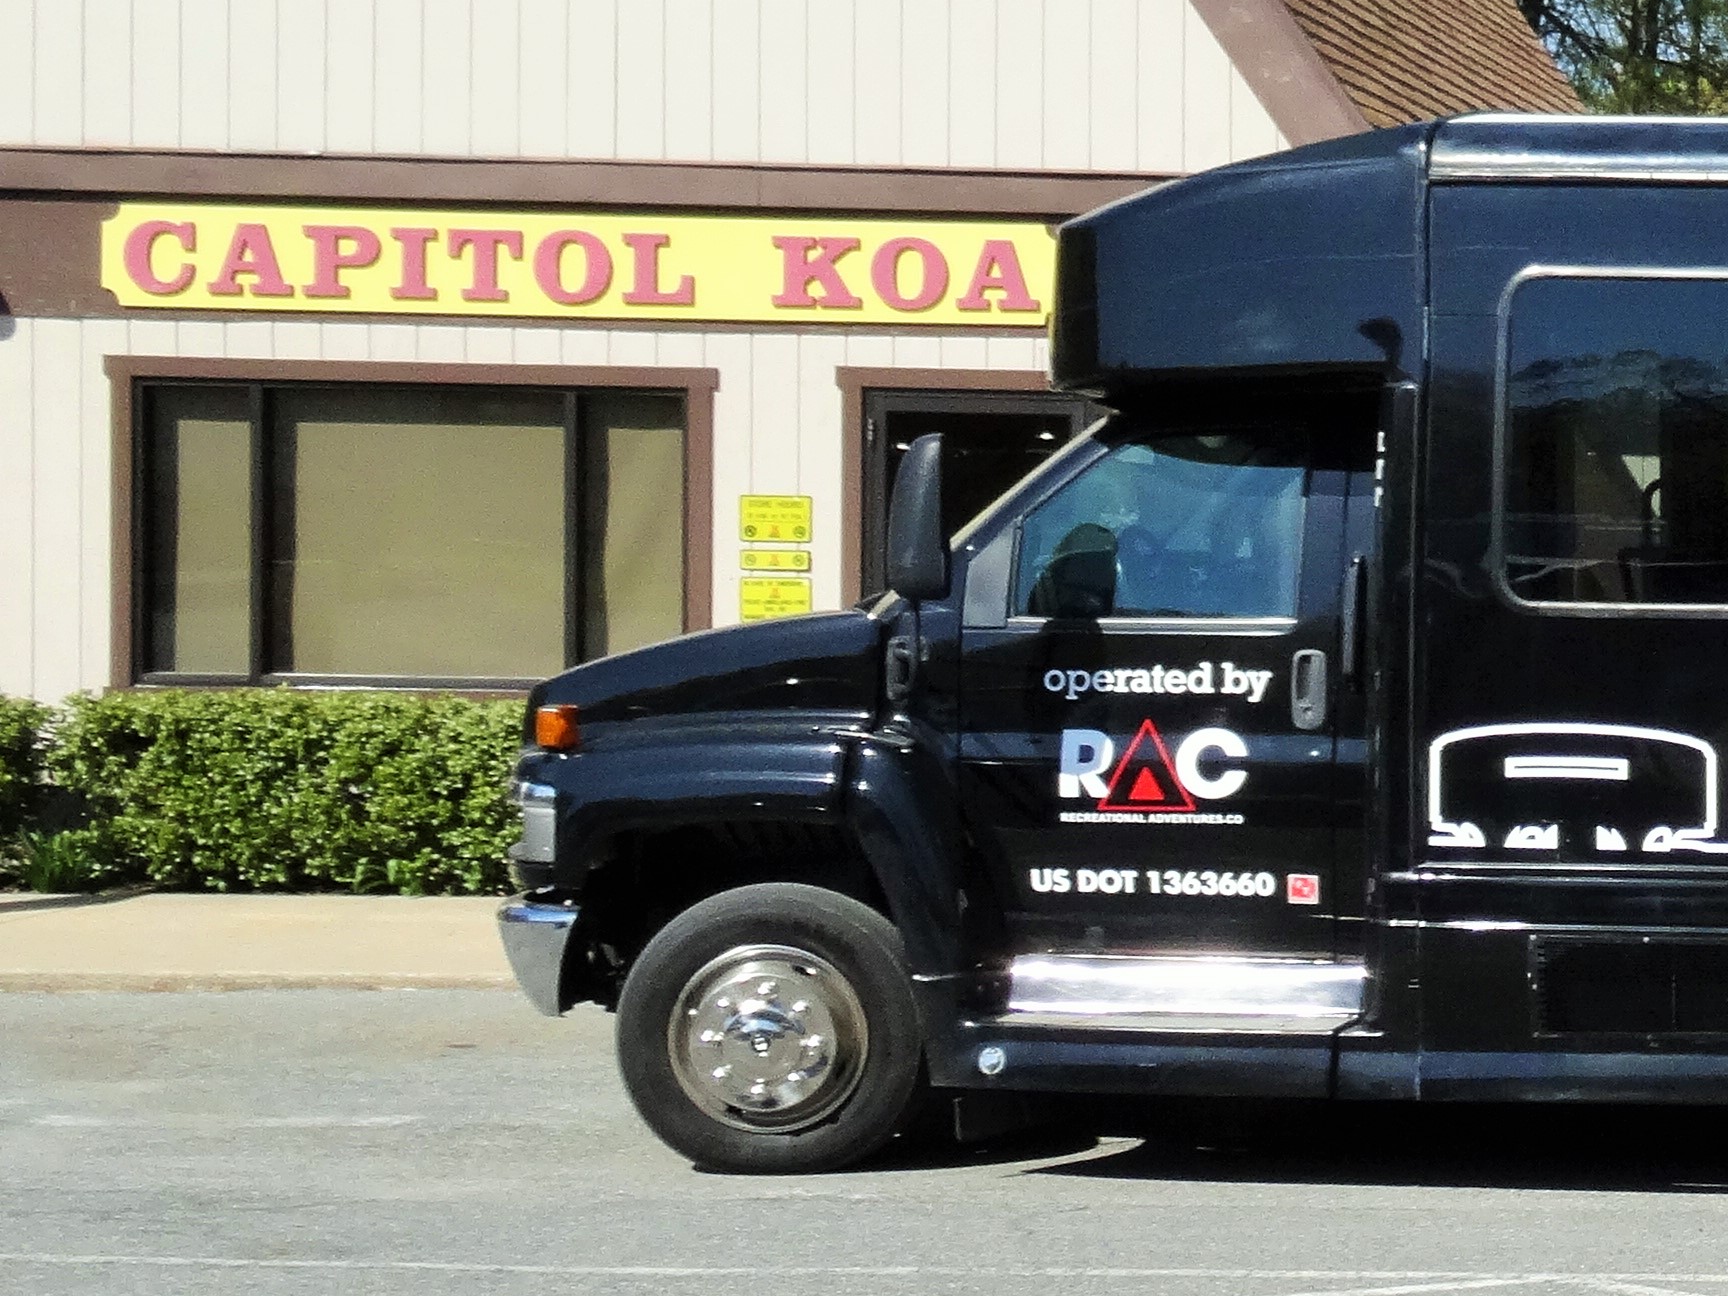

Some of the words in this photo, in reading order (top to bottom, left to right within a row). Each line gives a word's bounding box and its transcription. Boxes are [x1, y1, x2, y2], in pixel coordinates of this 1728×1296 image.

[122, 220, 696, 308] CAPITOL
[770, 234, 1041, 314] KOA
[1043, 662, 1213, 700] operated
[1219, 661, 1273, 702] by
[1058, 717, 1249, 812] RAC
[1059, 812, 1147, 823] RECREATIONAL
[1029, 868, 1071, 893] US
[1077, 869, 1138, 894] DOT
[1146, 870, 1276, 897] 1363660
